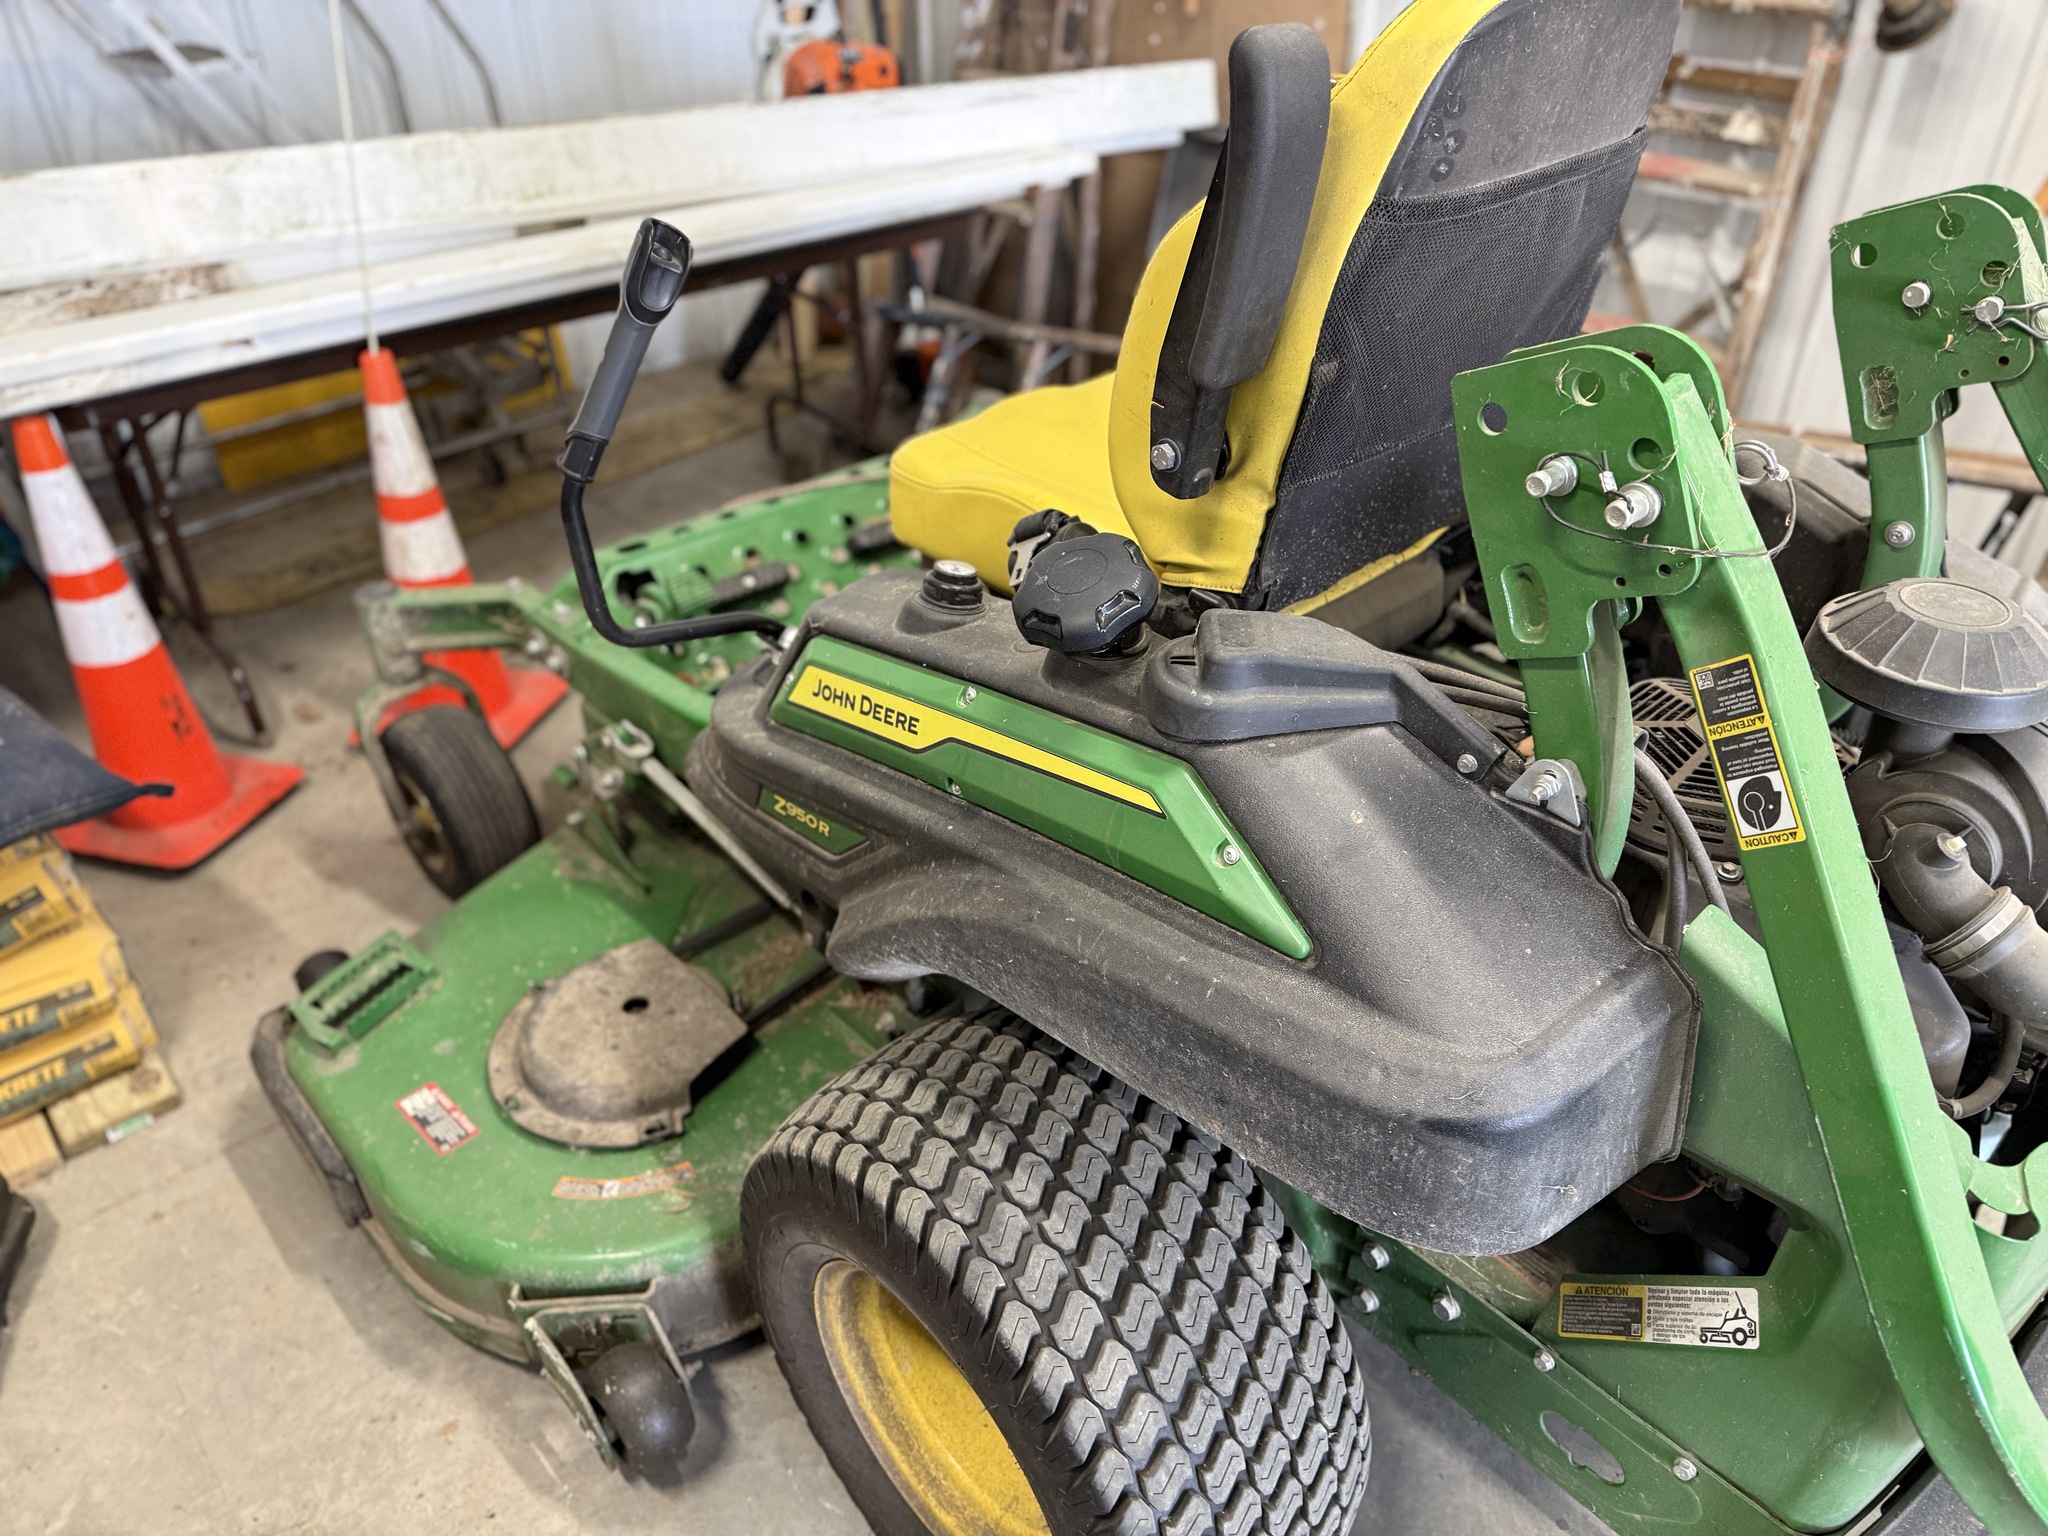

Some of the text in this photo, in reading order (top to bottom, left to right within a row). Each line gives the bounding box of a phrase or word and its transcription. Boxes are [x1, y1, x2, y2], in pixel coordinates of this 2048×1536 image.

[812, 678, 920, 736] JOHN DEERE
[1708, 717, 1757, 737] ATENCIÓN
[773, 794, 830, 839] Z950R
[1744, 832, 1789, 847] CAUTION
[1584, 1284, 1628, 1295] ATENCIÓN
